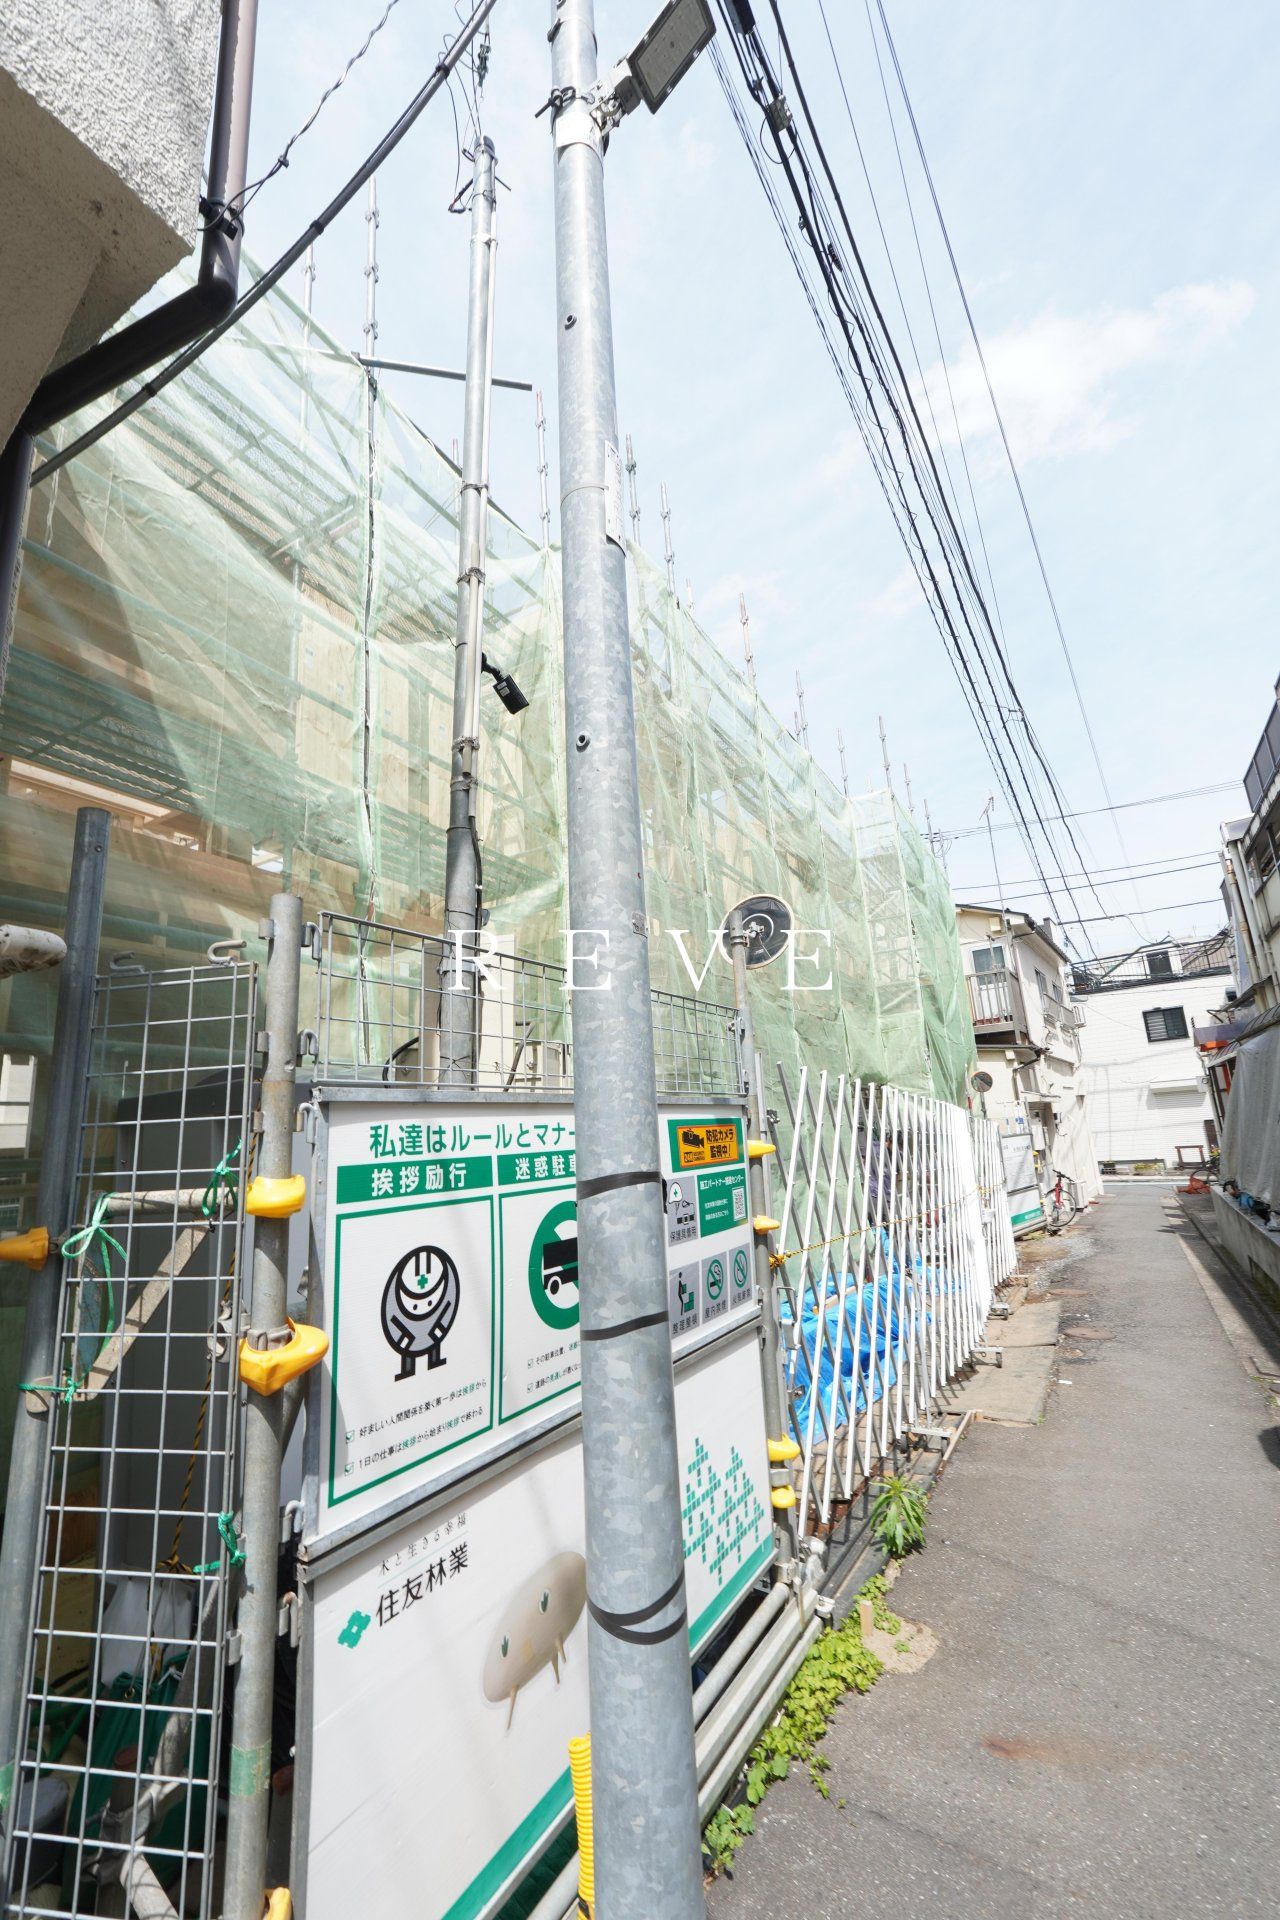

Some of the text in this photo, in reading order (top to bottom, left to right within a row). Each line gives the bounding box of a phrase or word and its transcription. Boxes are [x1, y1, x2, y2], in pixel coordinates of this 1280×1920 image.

[705, 1128, 735, 1143] 防犯カメラ
[371, 1162, 467, 1197] 挨拶励行
[376, 1541, 469, 1627] 住友林業
